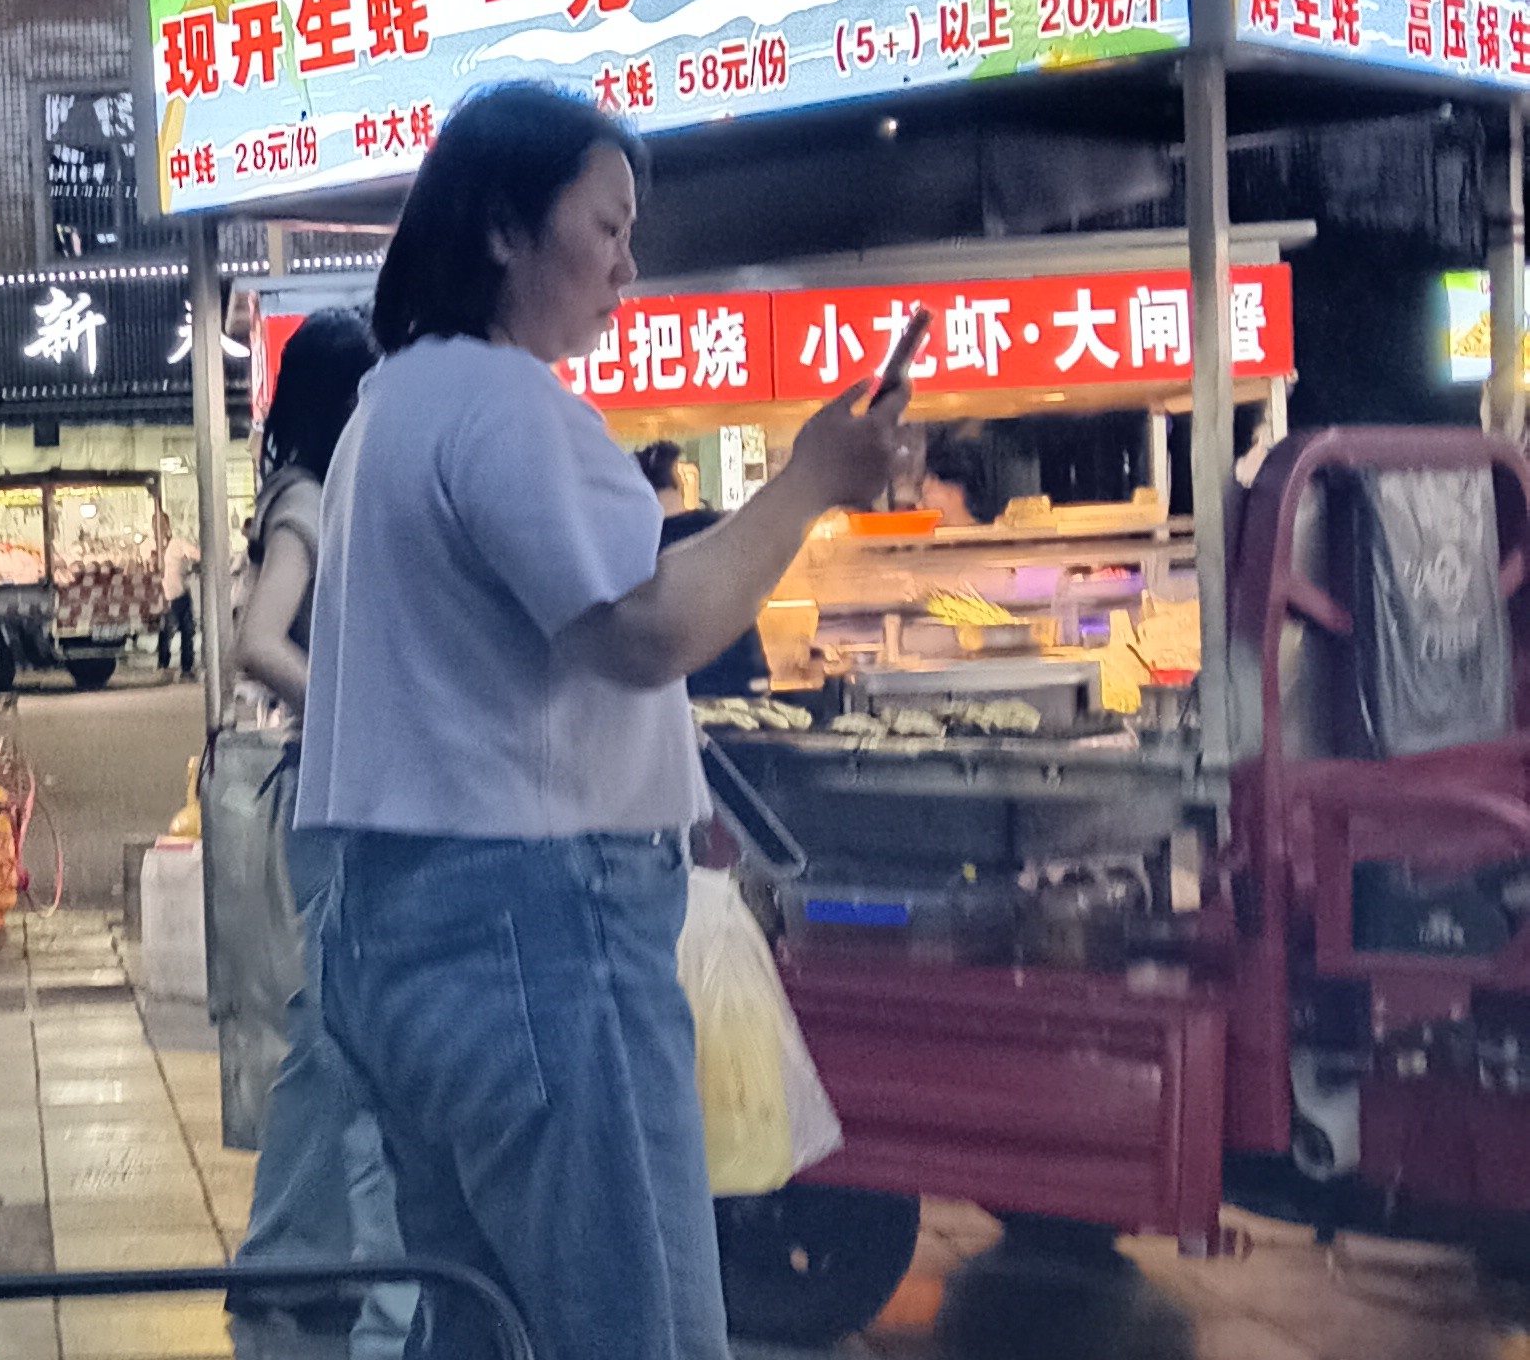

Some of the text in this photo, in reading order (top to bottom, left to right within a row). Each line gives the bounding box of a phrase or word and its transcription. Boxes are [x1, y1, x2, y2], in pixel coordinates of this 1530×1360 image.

[170, 142, 216, 189] 中蚝
[235, 126, 317, 174] 28元/份
[678, 36, 787, 95] 58元/份
